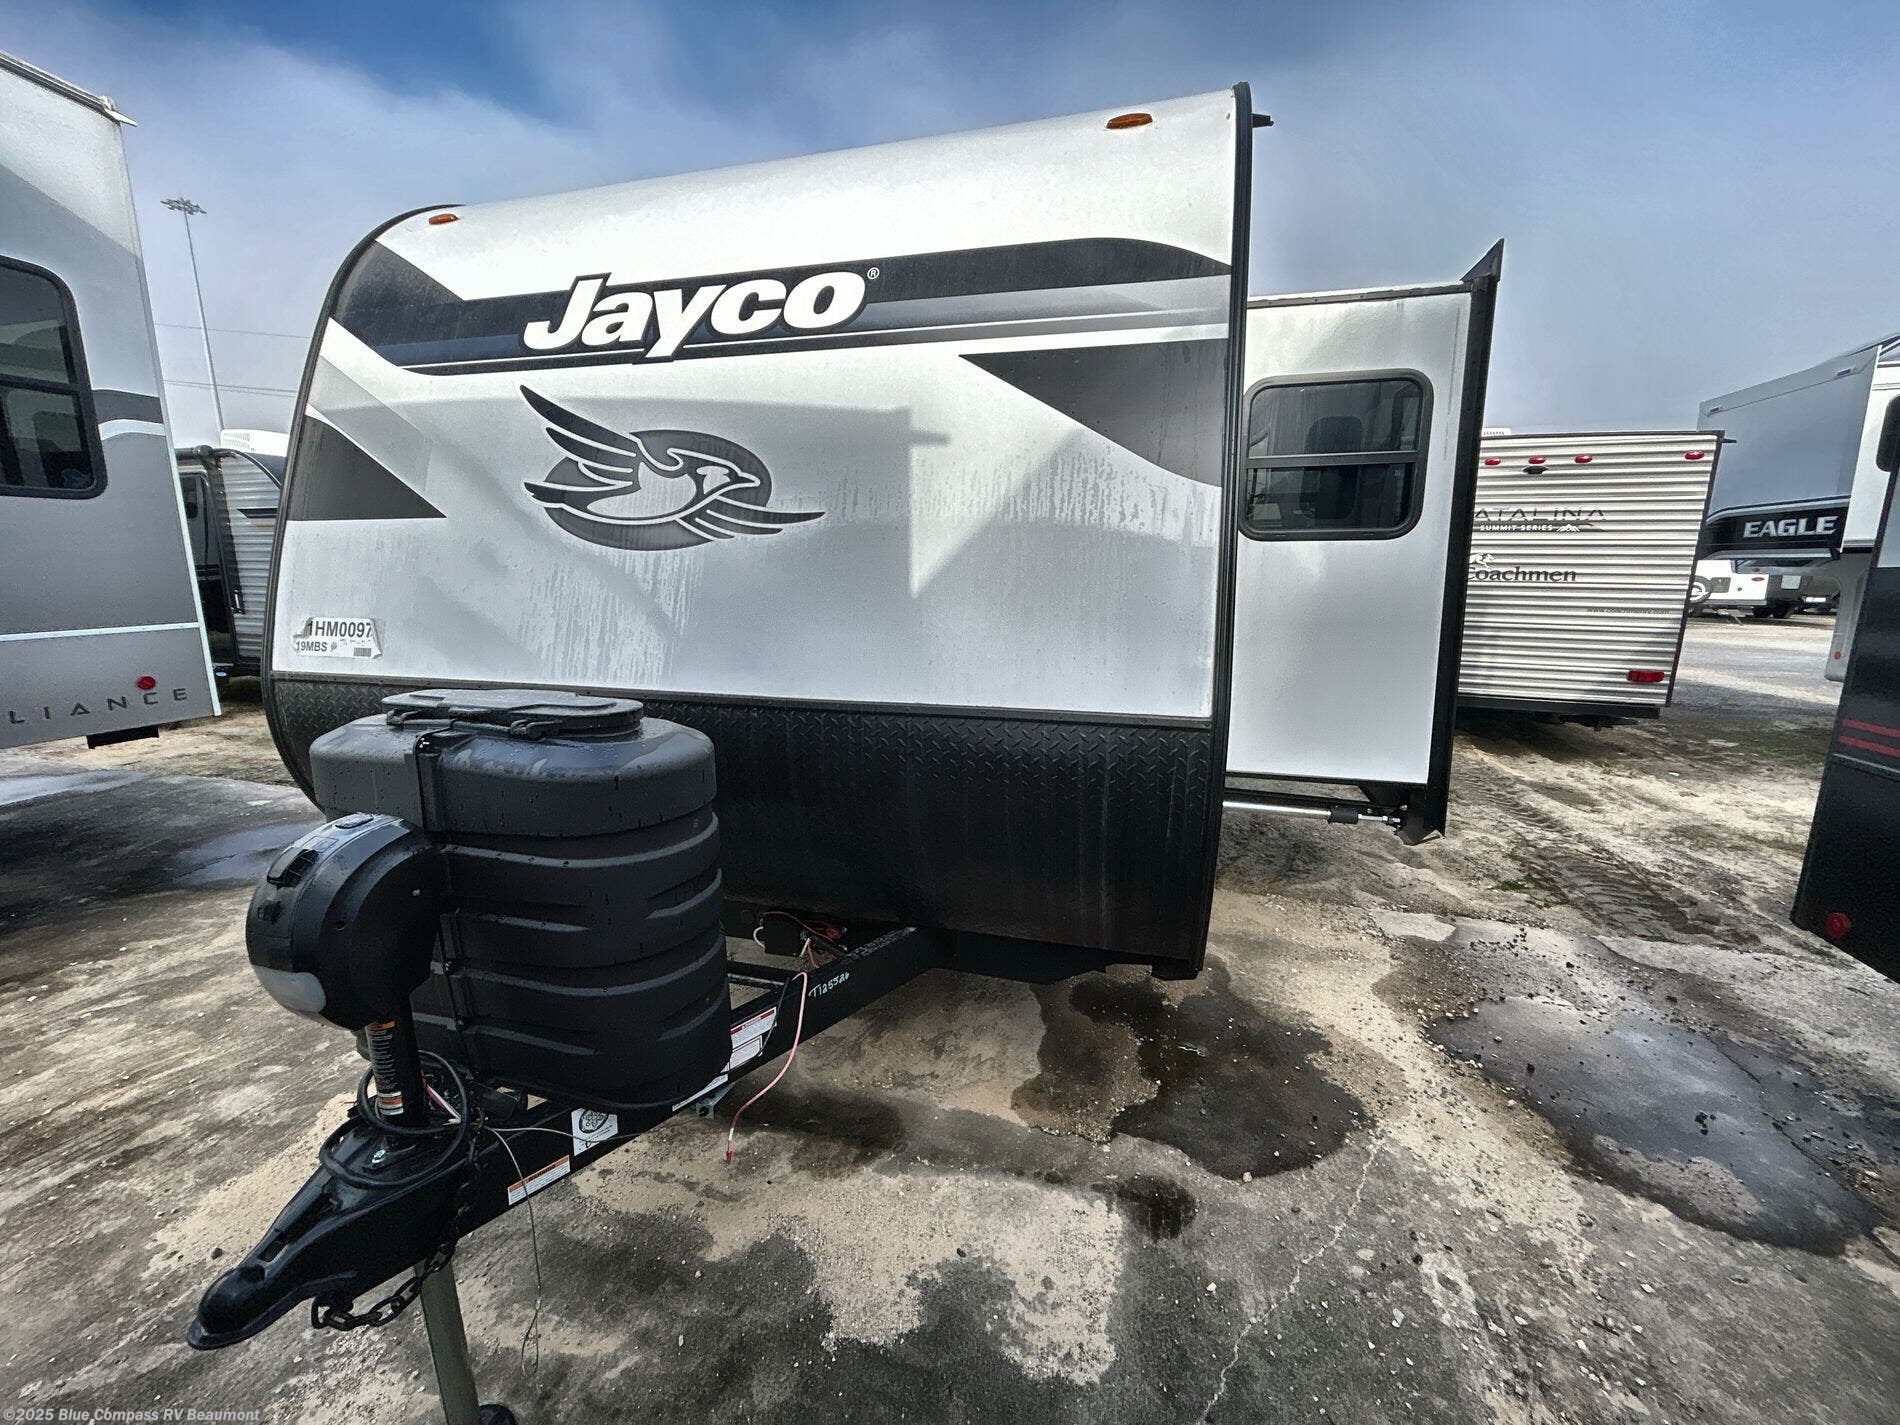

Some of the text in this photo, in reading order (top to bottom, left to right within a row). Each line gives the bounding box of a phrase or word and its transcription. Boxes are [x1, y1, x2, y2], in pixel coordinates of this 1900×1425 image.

[522, 270, 867, 358] Jayco
[1474, 508, 1607, 521] ATALINA
[1480, 524, 1554, 532] SUMMIT SERIES
[1743, 515, 1839, 538] EAGLE
[296, 641, 329, 653] 19MBS
